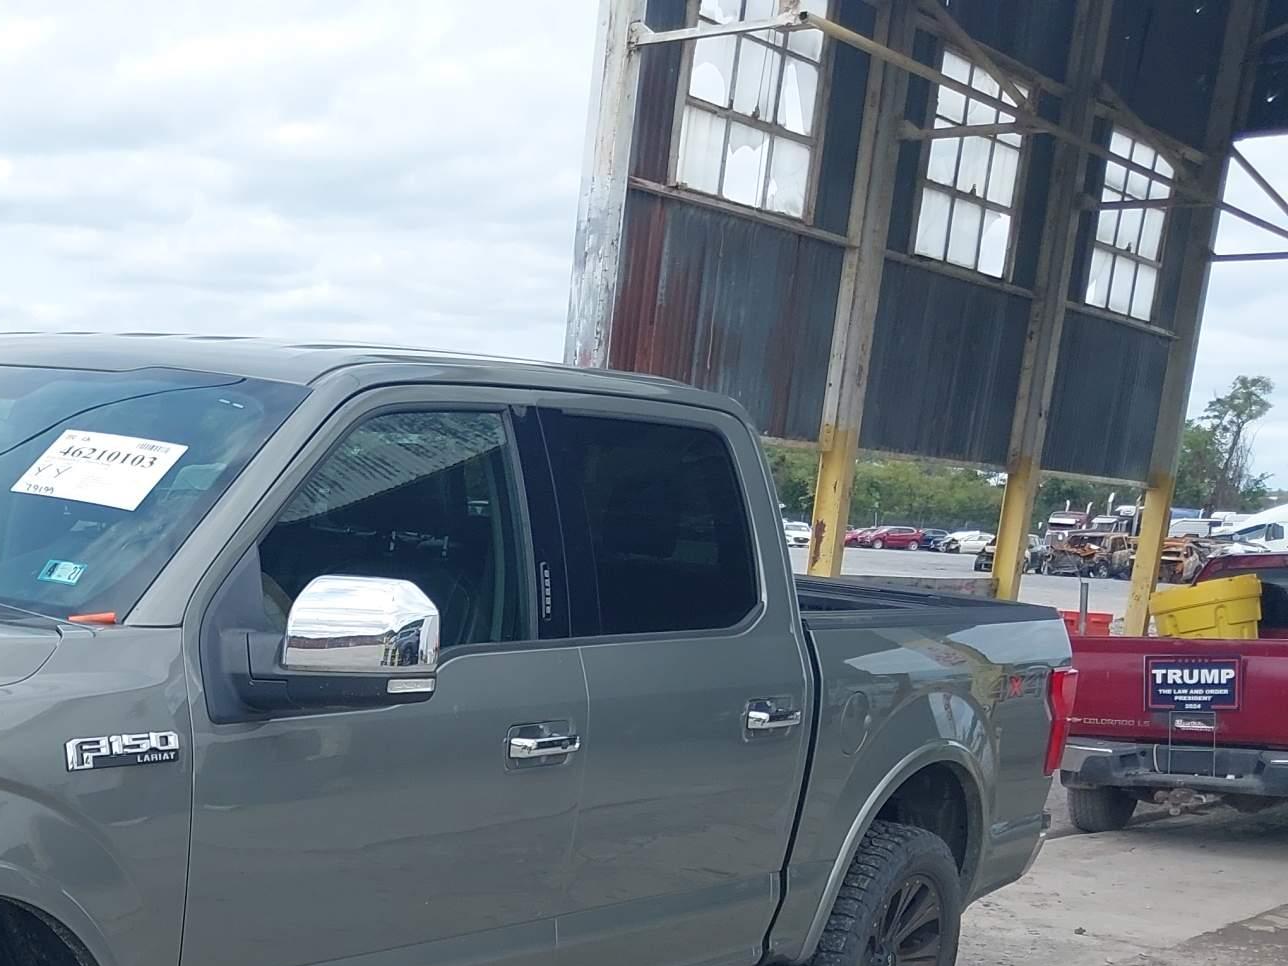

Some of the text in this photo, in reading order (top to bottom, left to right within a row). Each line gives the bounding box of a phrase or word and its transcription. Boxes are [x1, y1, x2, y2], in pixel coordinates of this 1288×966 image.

[59, 446, 158, 468] 46210103
[1152, 669, 1235, 684] TRUMP
[137, 752, 175, 763] LARIAT
